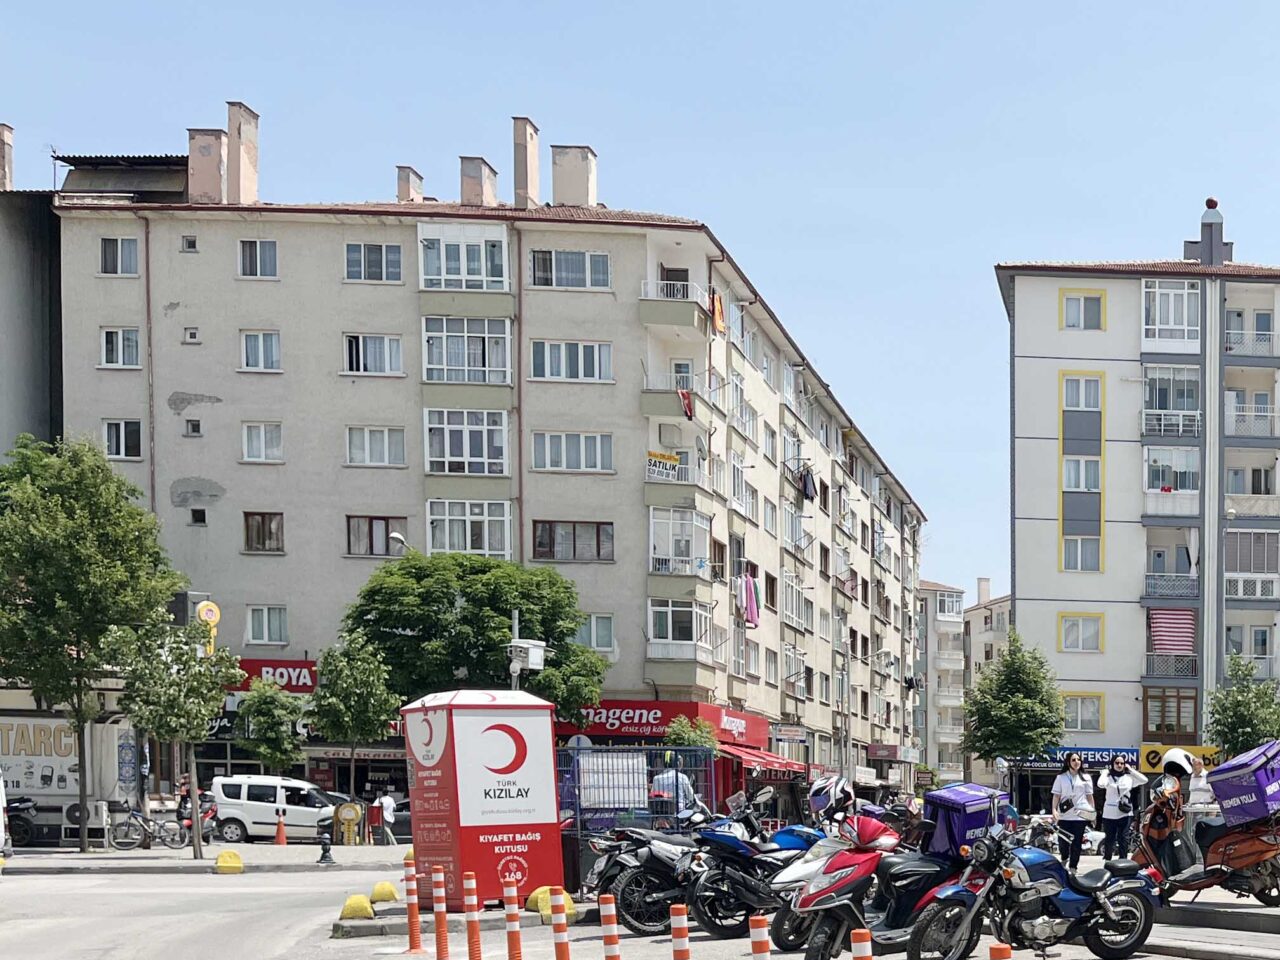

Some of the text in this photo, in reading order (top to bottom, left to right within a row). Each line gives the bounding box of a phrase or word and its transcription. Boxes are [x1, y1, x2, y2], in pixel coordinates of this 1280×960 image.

[648, 458, 677, 472] SATILIK
[261, 666, 313, 686] BOYA
[484, 788, 530, 799] KIZILAY
[1265, 783, 1280, 796] HEMEN
[1222, 792, 1257, 809] HEMEN YOLLA
[479, 832, 541, 843] KIYAFET BAĞIŞ
[494, 844, 528, 854] KUTUSU
[505, 872, 522, 881] 168
